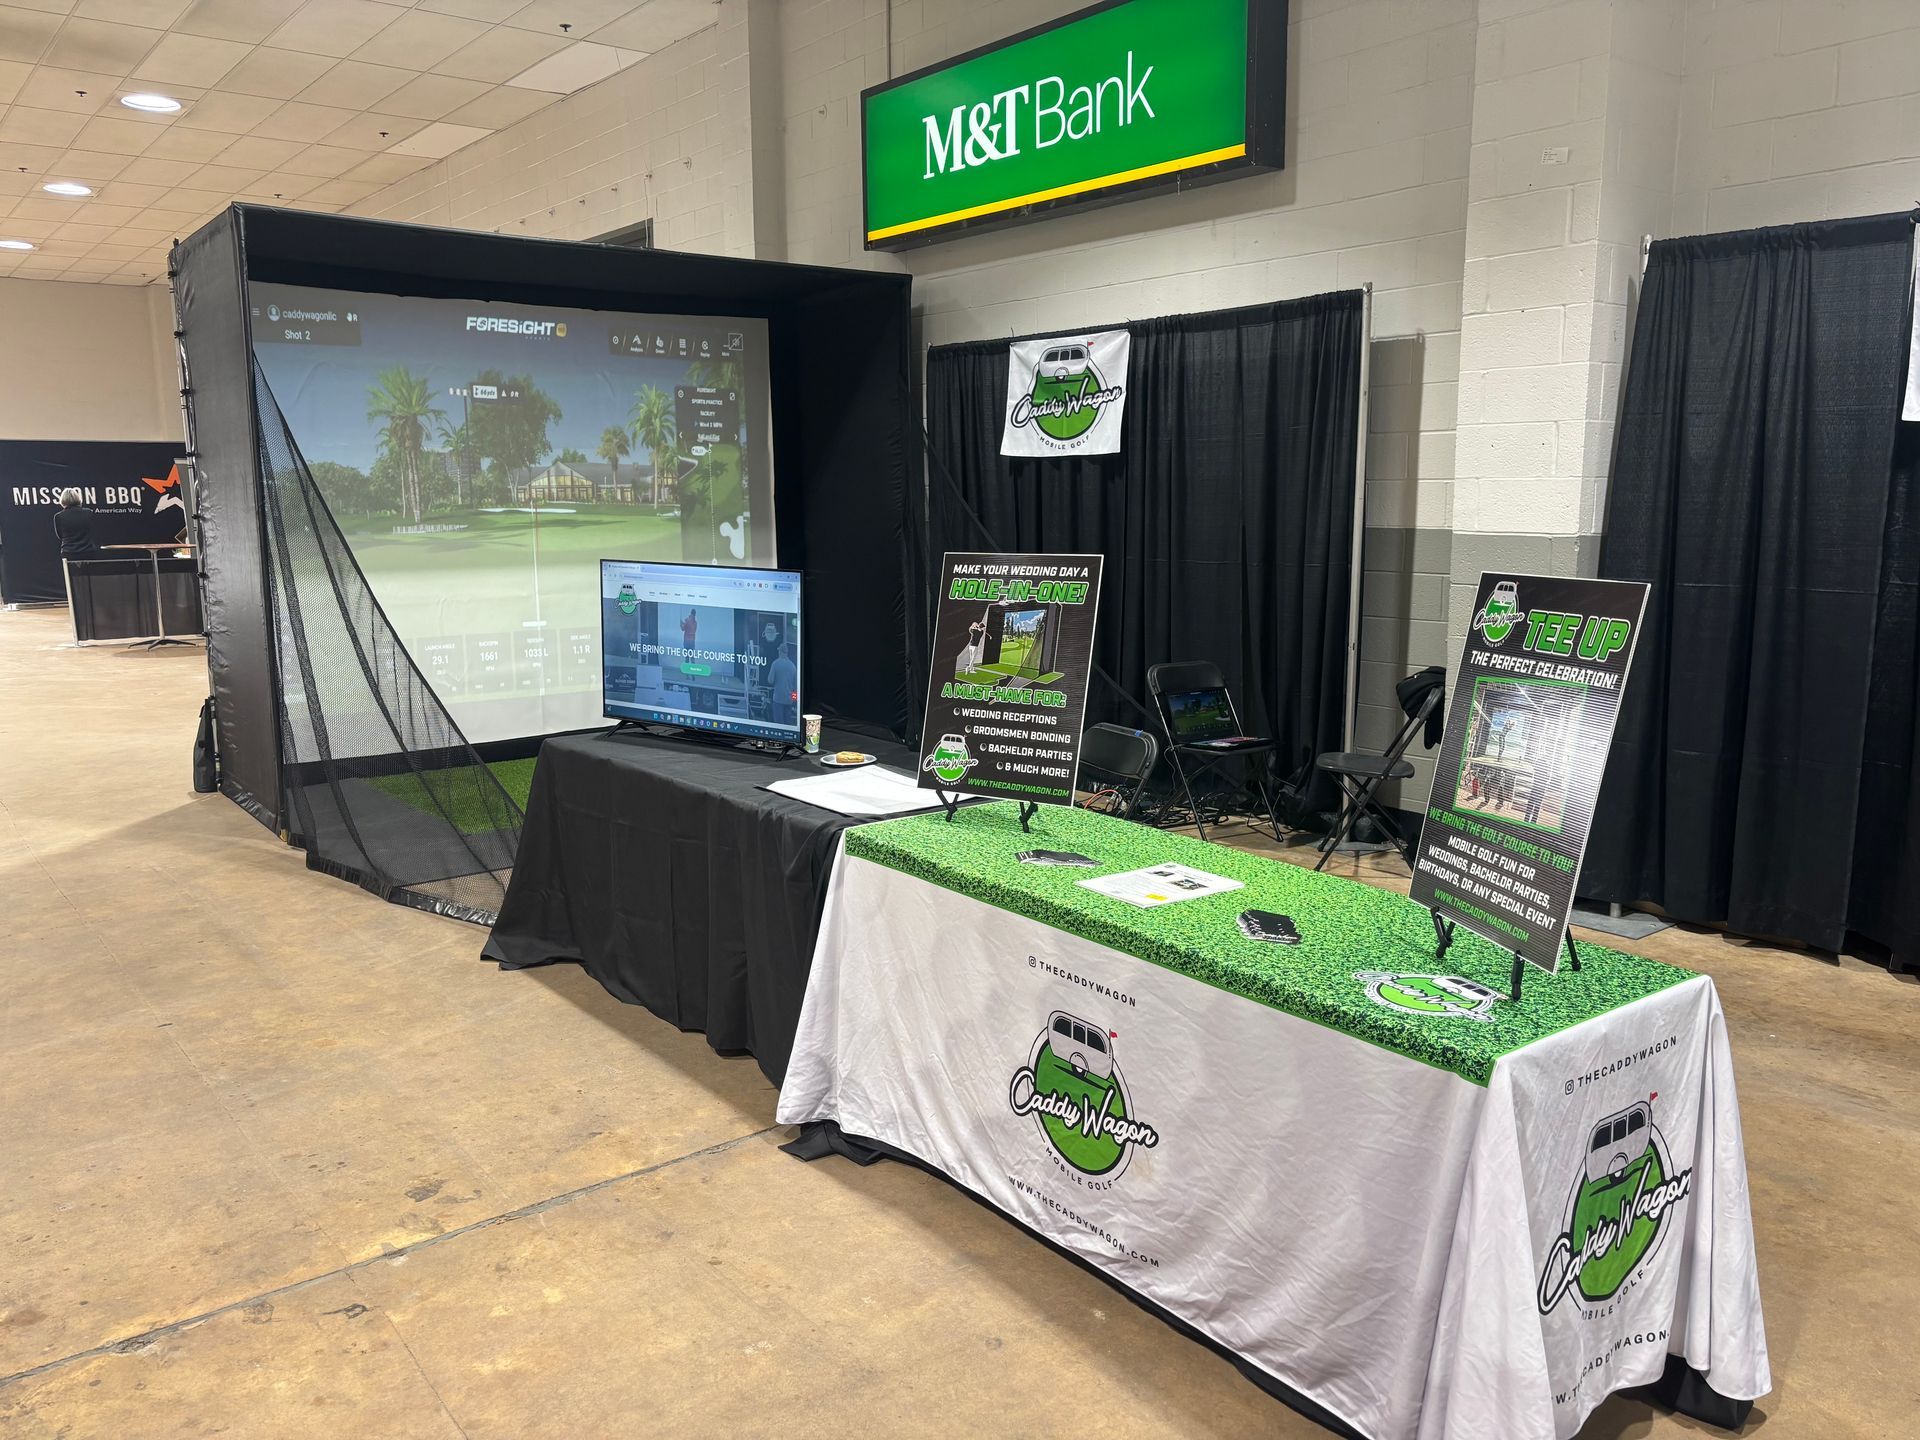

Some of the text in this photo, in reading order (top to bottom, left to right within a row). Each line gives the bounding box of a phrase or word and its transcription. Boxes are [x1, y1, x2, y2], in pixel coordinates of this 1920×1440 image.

[922, 50, 1156, 179] M&T Bank
[284, 329, 311, 340] Shot 2
[1011, 375, 1122, 428] Caddy Wagon
[1040, 434, 1090, 450] MOBILE GOLF
[12, 486, 142, 506] MISSON BBQ
[953, 564, 1089, 578] MAKE YOUR WEDDING DAY A
[949, 578, 1089, 604] HOLE-IN-ONE!
[1522, 608, 1631, 662] TEE UP
[432, 655, 449, 666] 29.1
[480, 652, 498, 662] 1661
[524, 648, 549, 658] 1033 L
[572, 644, 591, 655] 1.1 R
[630, 642, 767, 666] WE BRING THE GOLF COURSE TO YOU
[1470, 650, 1618, 690] THE PERFECT CELEBRATION!
[941, 682, 1068, 708] A MUST-HAVE FOR:
[962, 708, 1058, 726] WEDDING RECEPTIONS
[973, 726, 1072, 744] GROOMSMEN BONDING
[922, 750, 979, 772] Caddy Wagon
[988, 744, 1073, 762] BACHELOR PARTIES
[1005, 762, 1070, 778] & MUCH MORE!
[968, 778, 1070, 798] WWW.THECADDYWAGON.COM
[1429, 806, 1442, 820] WE
[1442, 811, 1464, 830] BRING
[1466, 820, 1481, 834] THE
[1482, 824, 1504, 844] GOLF
[1503, 833, 1537, 858] COURSE
[1538, 846, 1550, 863] TO
[1448, 835, 1536, 881] MOBILE GOLF FUN FOR
[1428, 844, 1550, 910] WEDDINGS, BACHELOR PARTIES,
[1418, 858, 1556, 931] BIRTHDAYS, OR ANY SPECIAL EVENT
[1434, 888, 1530, 943] WWW.THECADDYWAGON.COM
[1039, 960, 1136, 1007] THECADDYWAGON
[1578, 1036, 1677, 1088] THECADDYWAGON
[1010, 1066, 1159, 1148] Caddy Wagon
[1046, 1147, 1112, 1191] MOBILE GOLF
[1009, 1176, 1160, 1268] WWW.THECADDYWAGON.COM
